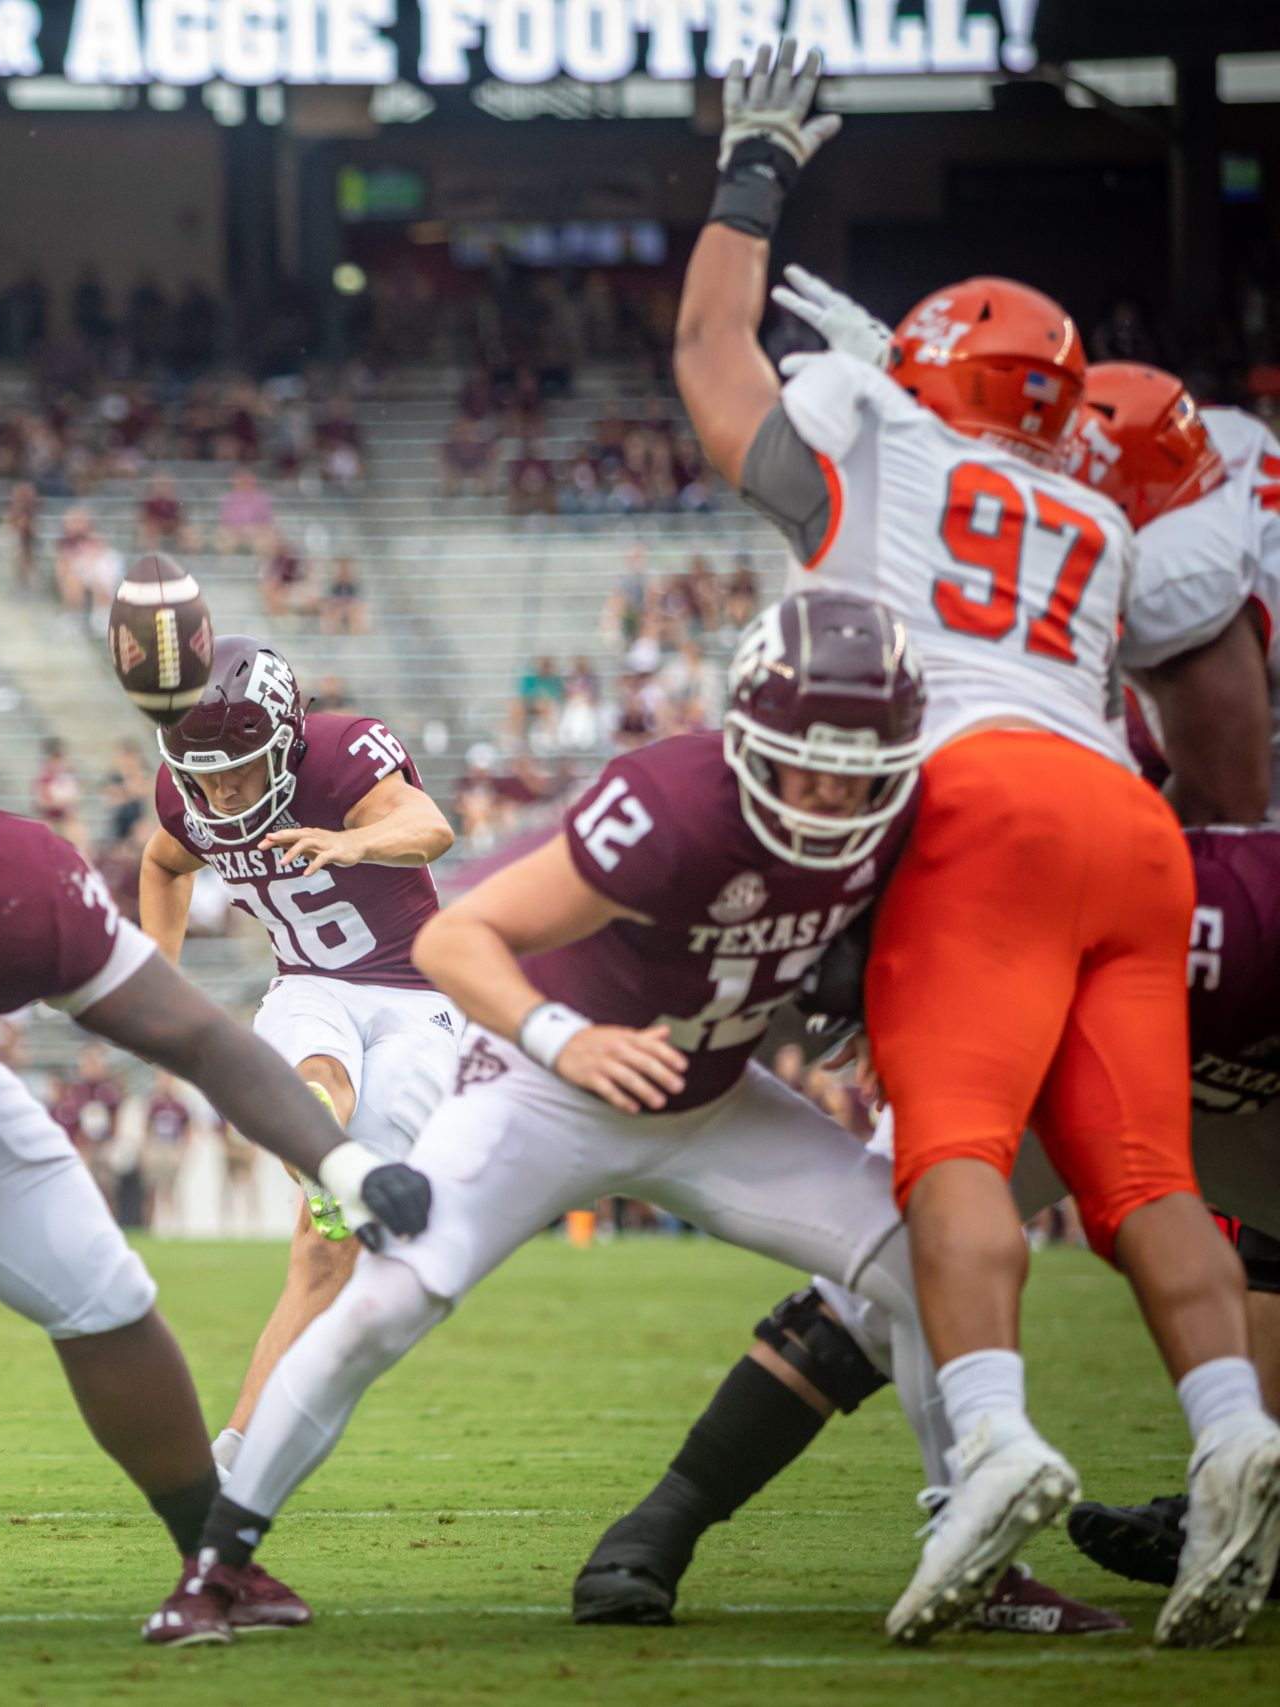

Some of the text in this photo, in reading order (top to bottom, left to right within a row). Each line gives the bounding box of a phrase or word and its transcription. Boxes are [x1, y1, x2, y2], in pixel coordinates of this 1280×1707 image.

[63, 0, 398, 84] AGGIE
[417, 0, 1039, 82] FOOTBALL!
[932, 461, 1105, 665] 97
[192, 754, 217, 763] AGGIES
[348, 723, 407, 781] 36
[573, 777, 654, 873] 12
[687, 909, 822, 955] TEXAS
